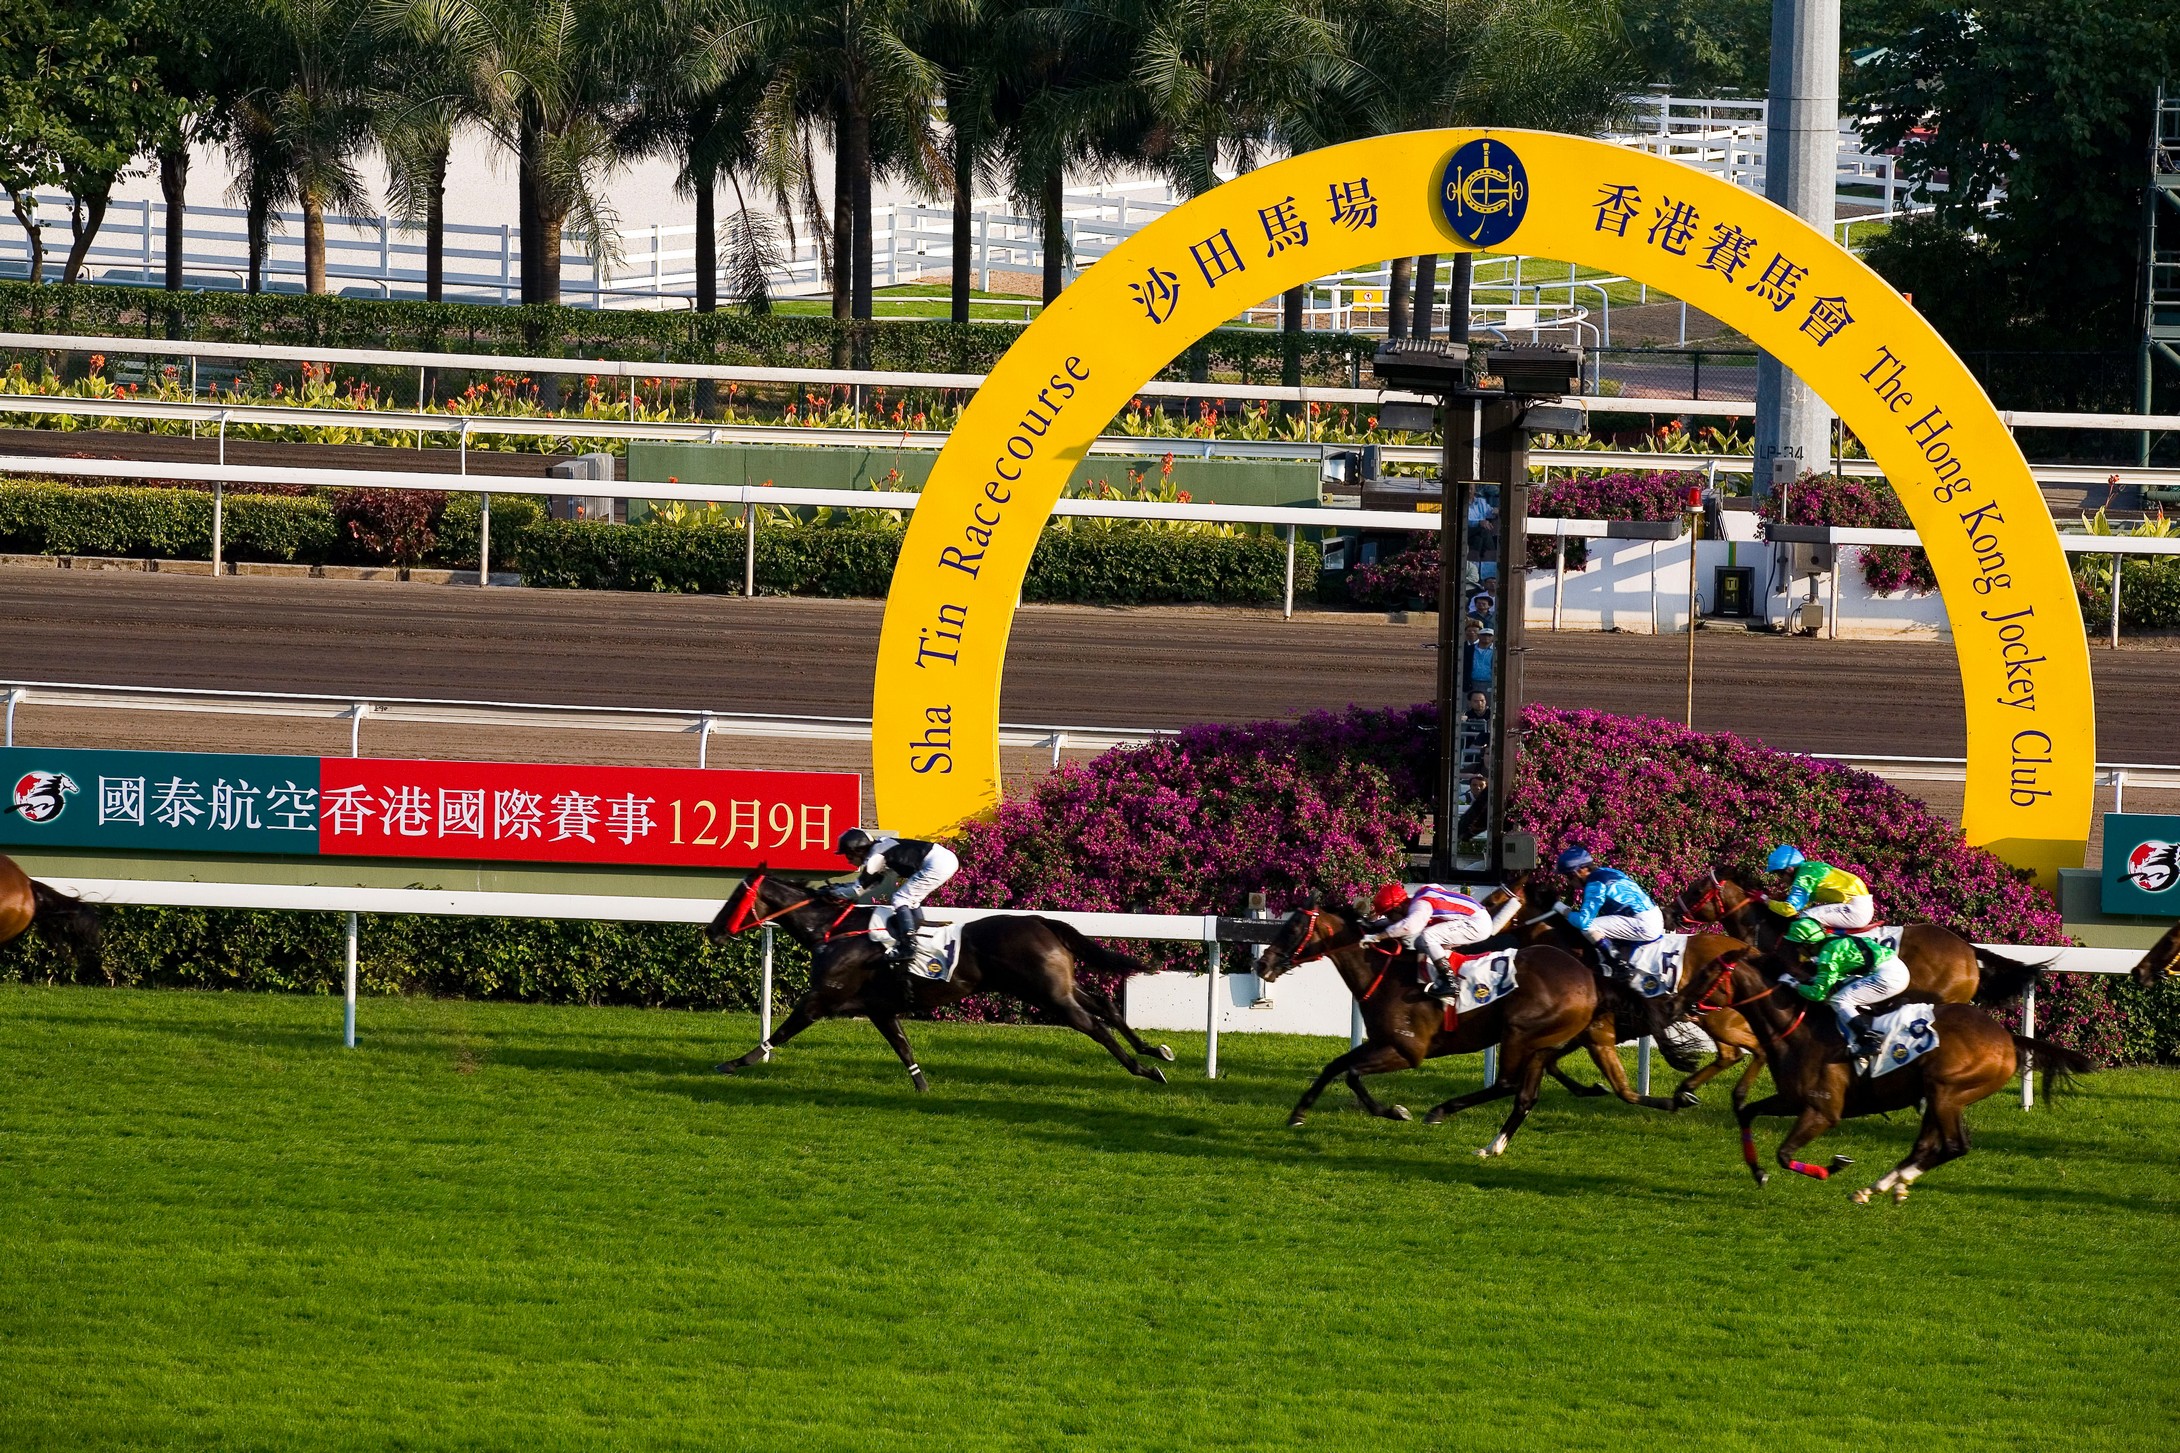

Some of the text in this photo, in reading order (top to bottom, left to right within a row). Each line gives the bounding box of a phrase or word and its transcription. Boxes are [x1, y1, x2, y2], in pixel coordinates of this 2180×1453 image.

[1128, 178, 1378, 324] 沙田馬場
[1592, 183, 1855, 347] 香港賽馬會
[910, 353, 1090, 774] Sha Tin Racecourse
[1860, 345, 2052, 807] The Hong Kong Jockey Club
[98, 776, 833, 851] 國泰航空 香港國際賽事 12月9日
[1490, 955, 1515, 997] 2
[1662, 950, 1680, 993] 5
[1909, 1017, 1934, 1054] 9
